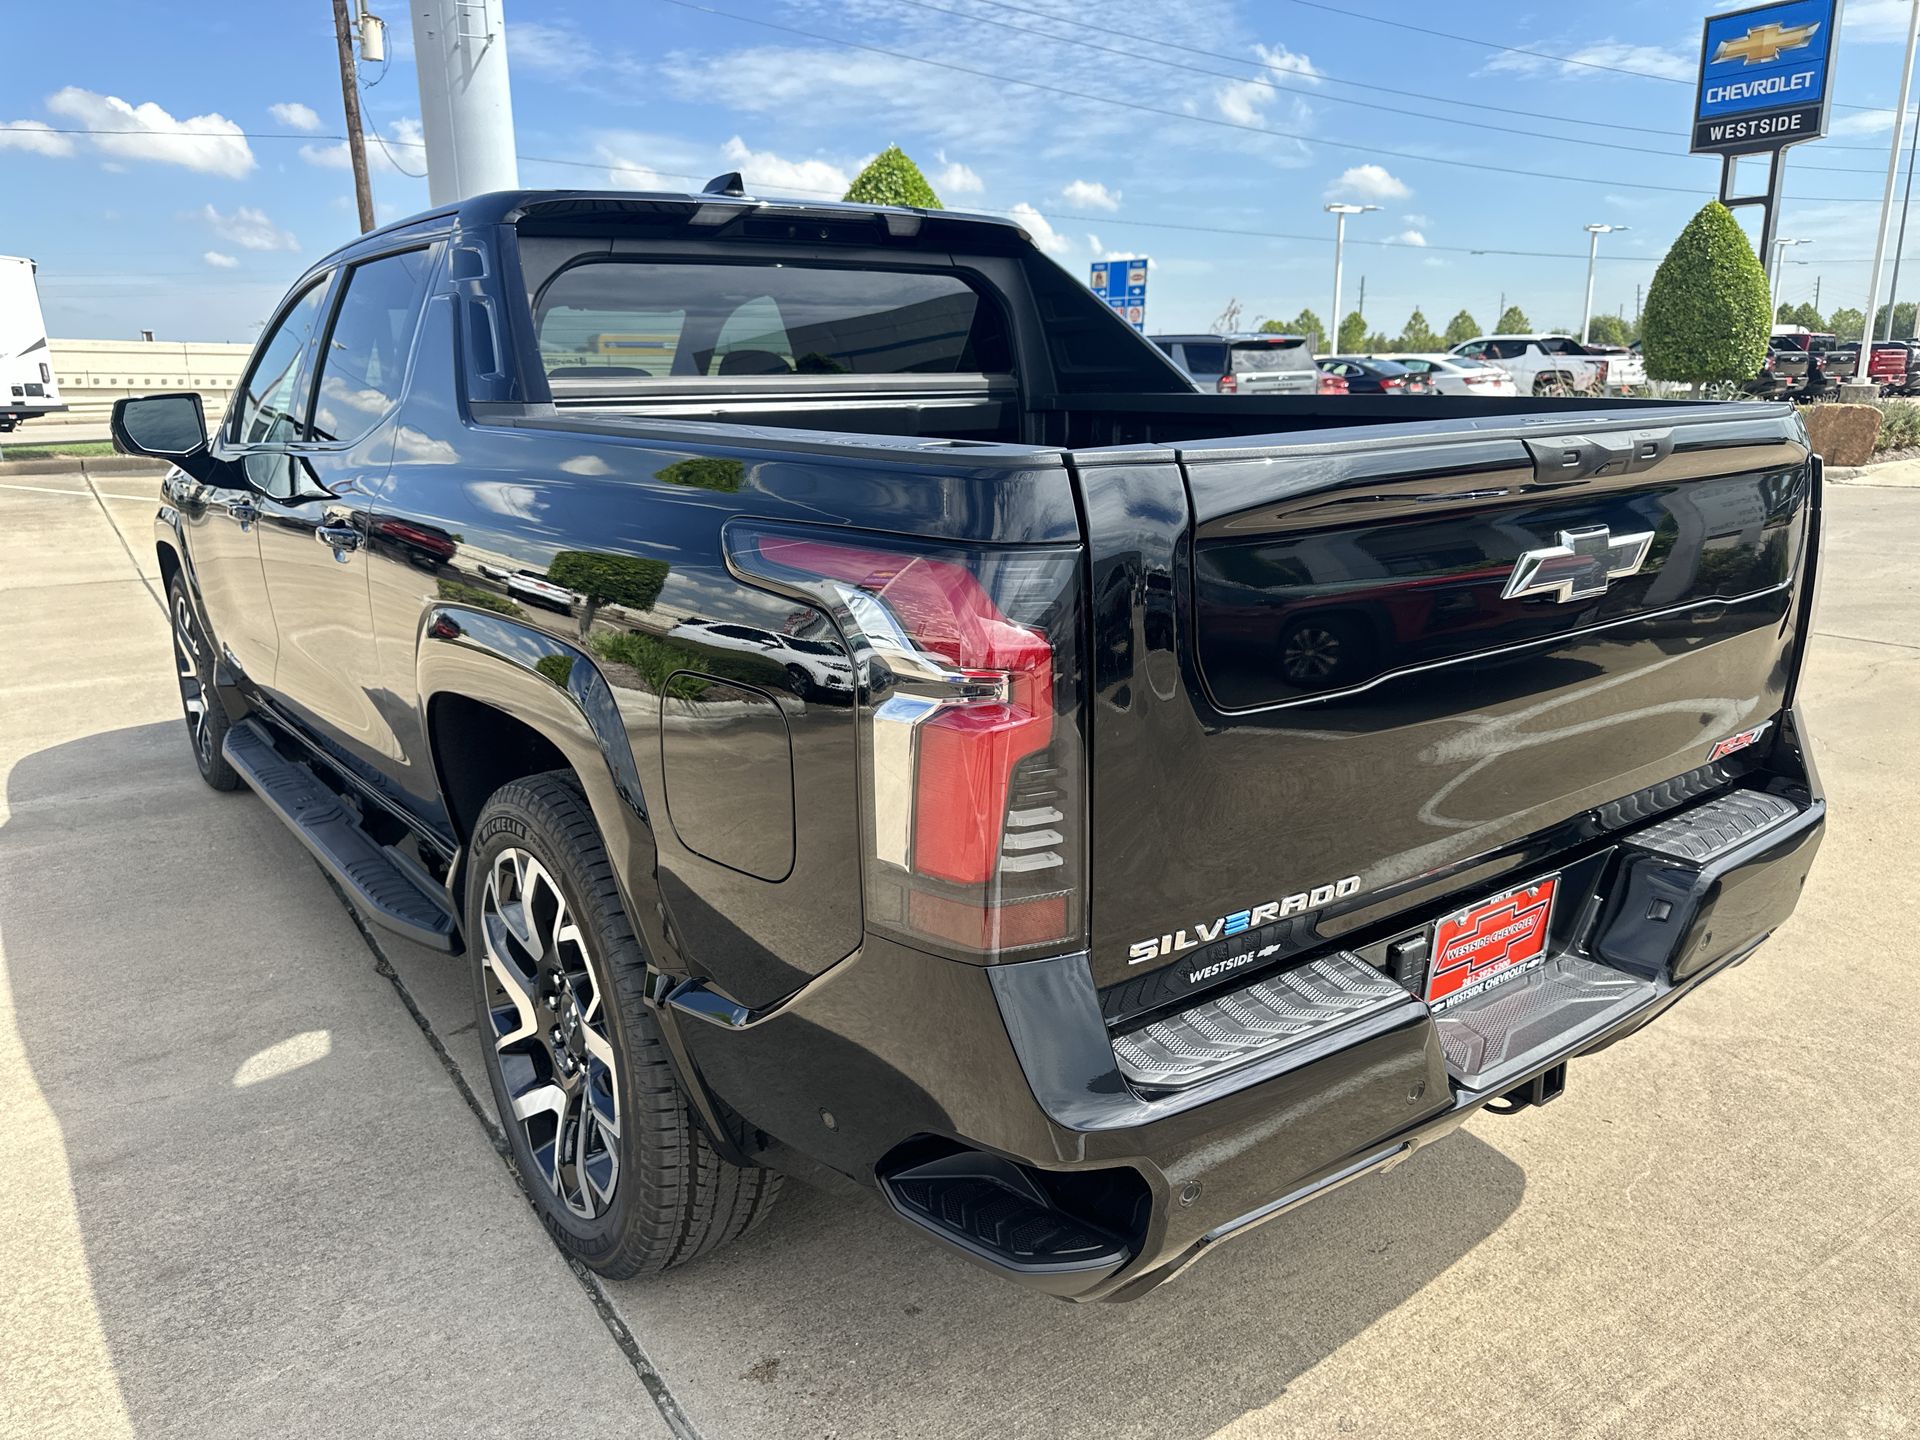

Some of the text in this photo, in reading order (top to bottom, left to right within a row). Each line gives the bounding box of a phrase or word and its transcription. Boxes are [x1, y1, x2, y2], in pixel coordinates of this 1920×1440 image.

[1706, 71, 1815, 104] CHEVROLET
[1710, 114, 1801, 141] WESTSIDE
[1706, 720, 1773, 762] RST
[481, 817, 525, 842] MICHELIN
[1128, 875, 1361, 965] SILVERADO
[1447, 915, 1536, 961] WESTSIDE CHEVROLET
[1189, 951, 1254, 984] WESTSIDE
[1446, 962, 1528, 1008] WESTSIDE CHEVROLET
